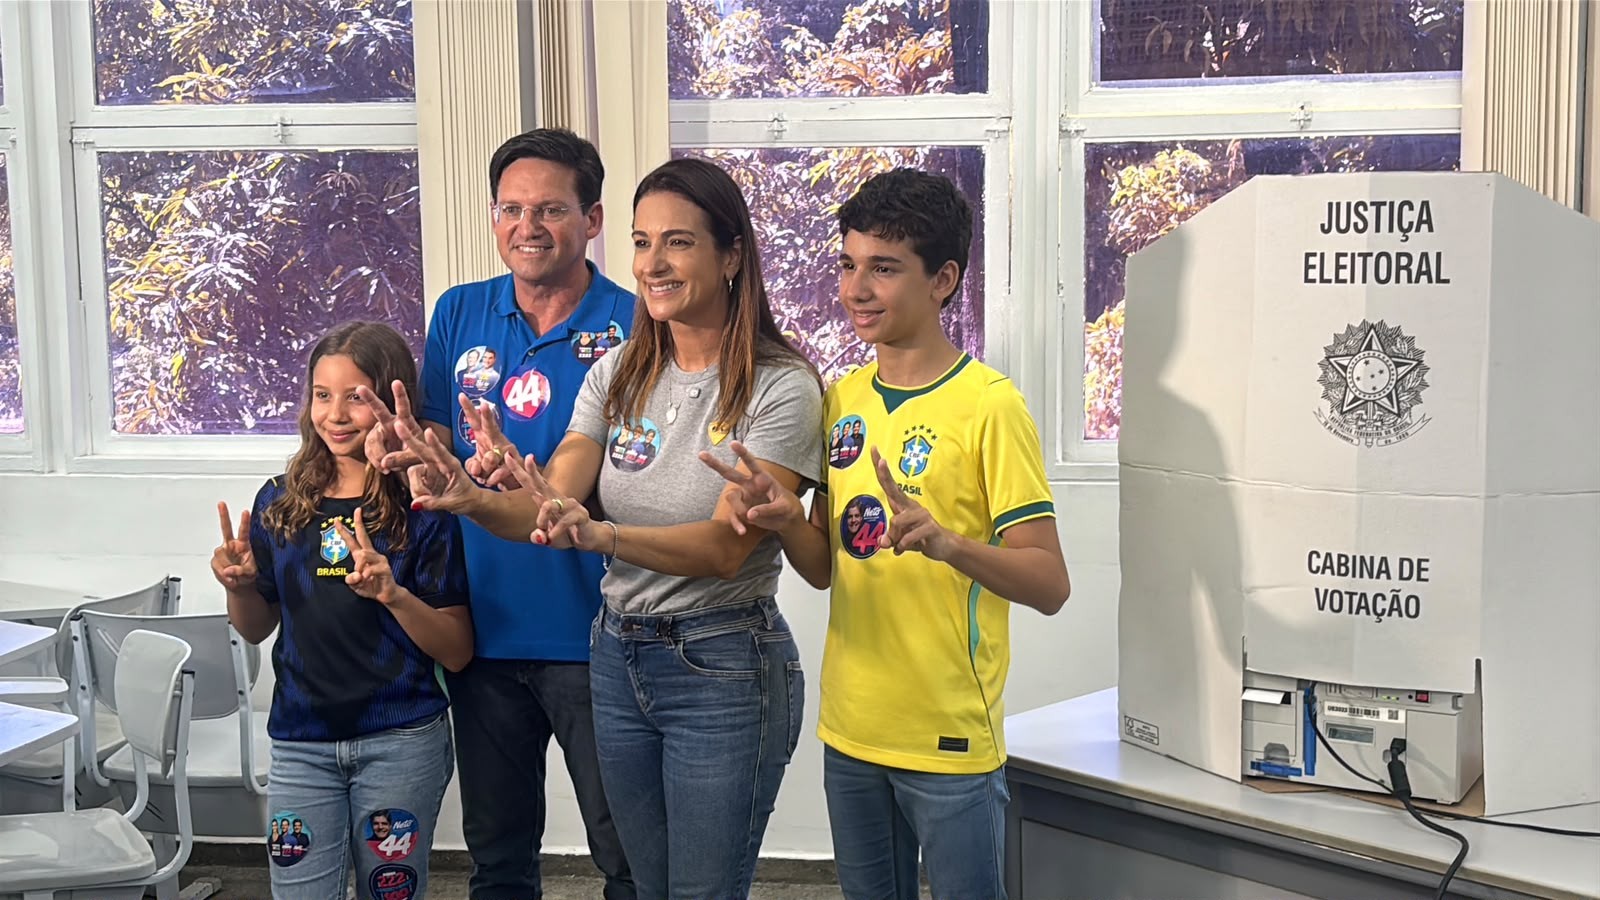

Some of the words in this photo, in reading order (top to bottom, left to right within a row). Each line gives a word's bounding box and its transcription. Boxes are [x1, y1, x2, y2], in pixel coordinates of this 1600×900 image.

[1320, 200, 1434, 242] JUSTIÇA
[1303, 251, 1450, 284] ELEITORAL
[505, 374, 541, 411] 44
[316, 567, 349, 577] BRASIL
[1307, 550, 1391, 581] CABINA
[1398, 557, 1430, 582] DE
[1314, 587, 1421, 623] VOTAÇÃO
[378, 832, 413, 857] 44
